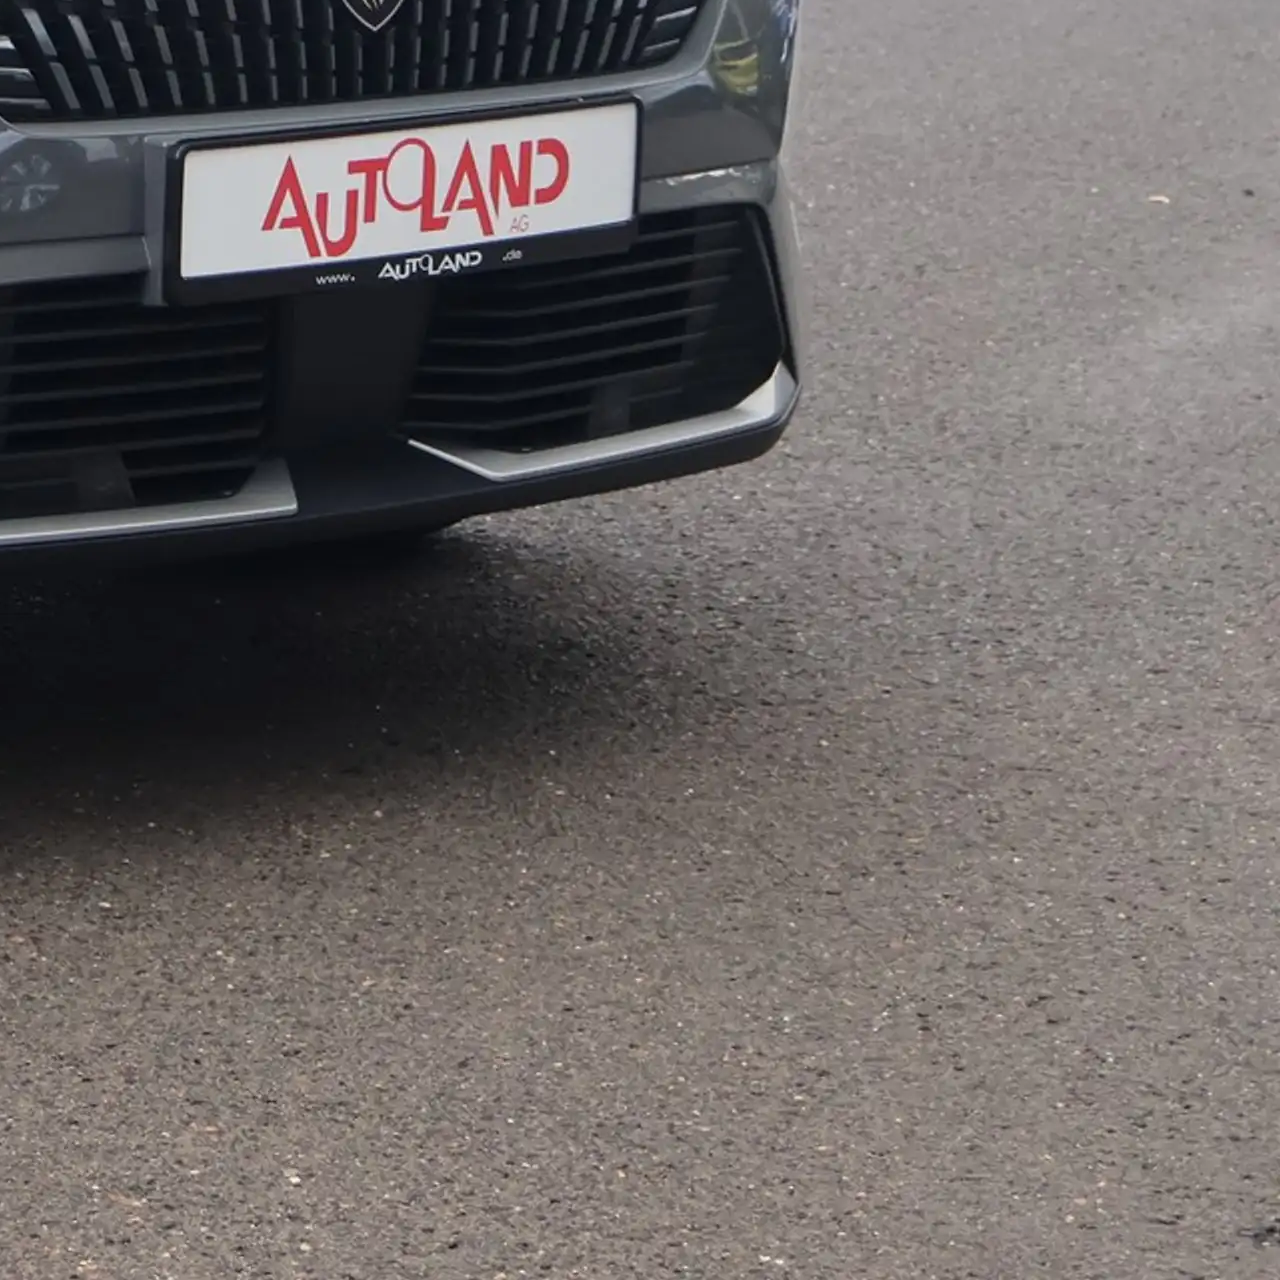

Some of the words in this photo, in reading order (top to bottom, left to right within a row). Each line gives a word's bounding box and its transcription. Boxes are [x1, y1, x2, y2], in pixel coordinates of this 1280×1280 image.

[261, 137, 571, 259] AUTOLAND
[508, 214, 530, 234] AG
[377, 250, 483, 282] AUTOLAND
